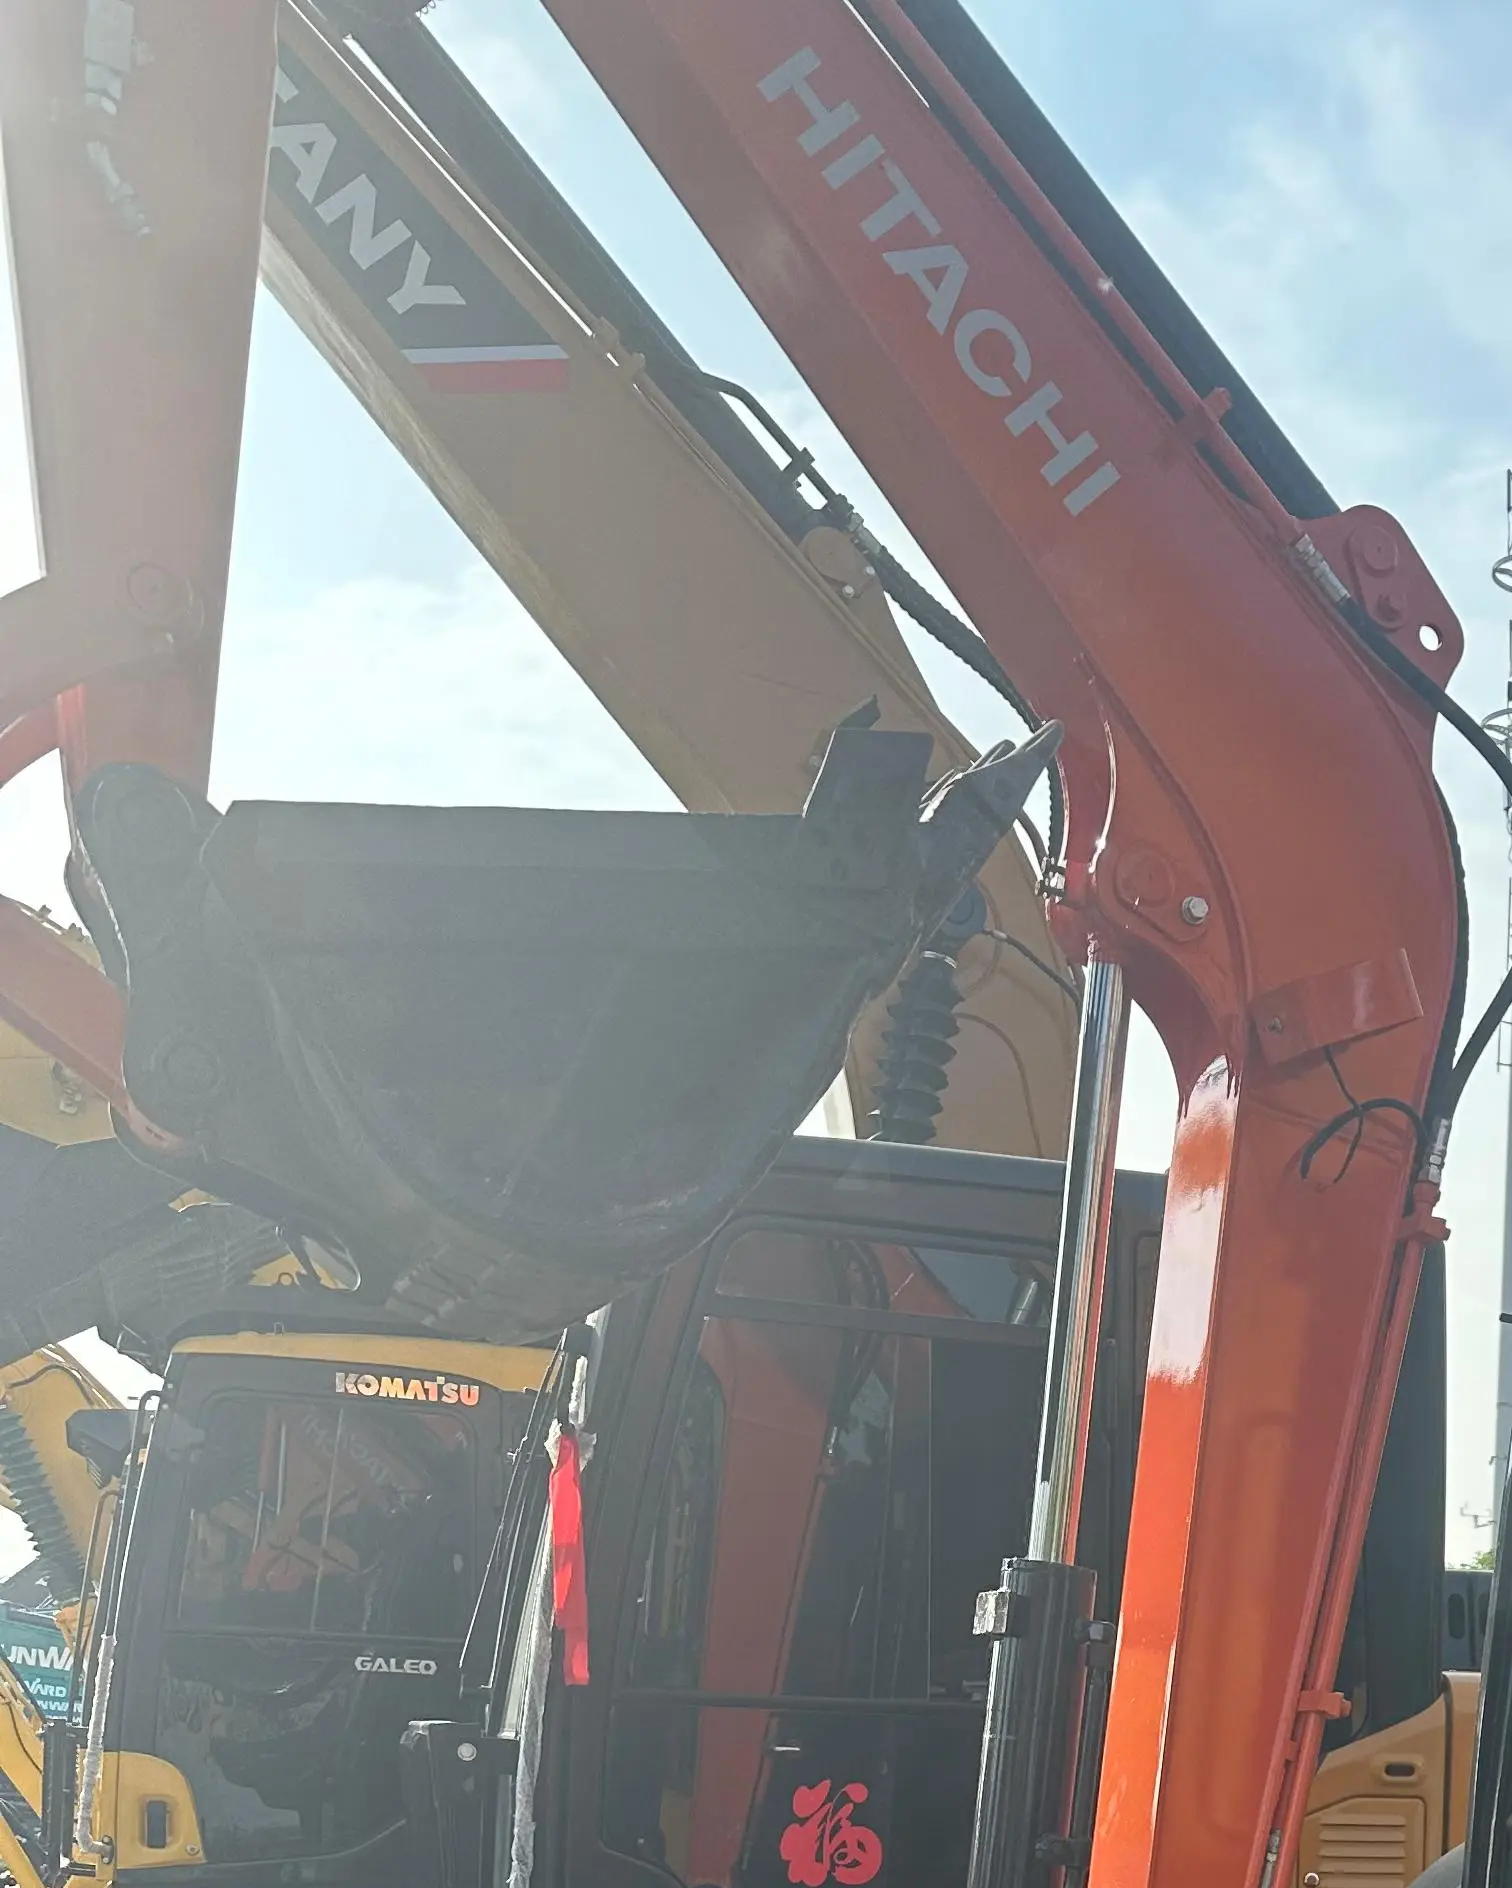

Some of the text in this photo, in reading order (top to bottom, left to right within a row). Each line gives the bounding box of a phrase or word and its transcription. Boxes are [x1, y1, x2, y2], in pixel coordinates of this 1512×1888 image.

[270, 66, 467, 315] ANY
[756, 46, 1121, 517] HITACHI
[335, 1372, 480, 1406] KOMATSU
[354, 1656, 437, 1675] GALEO
[780, 1779, 882, 1887] 福
